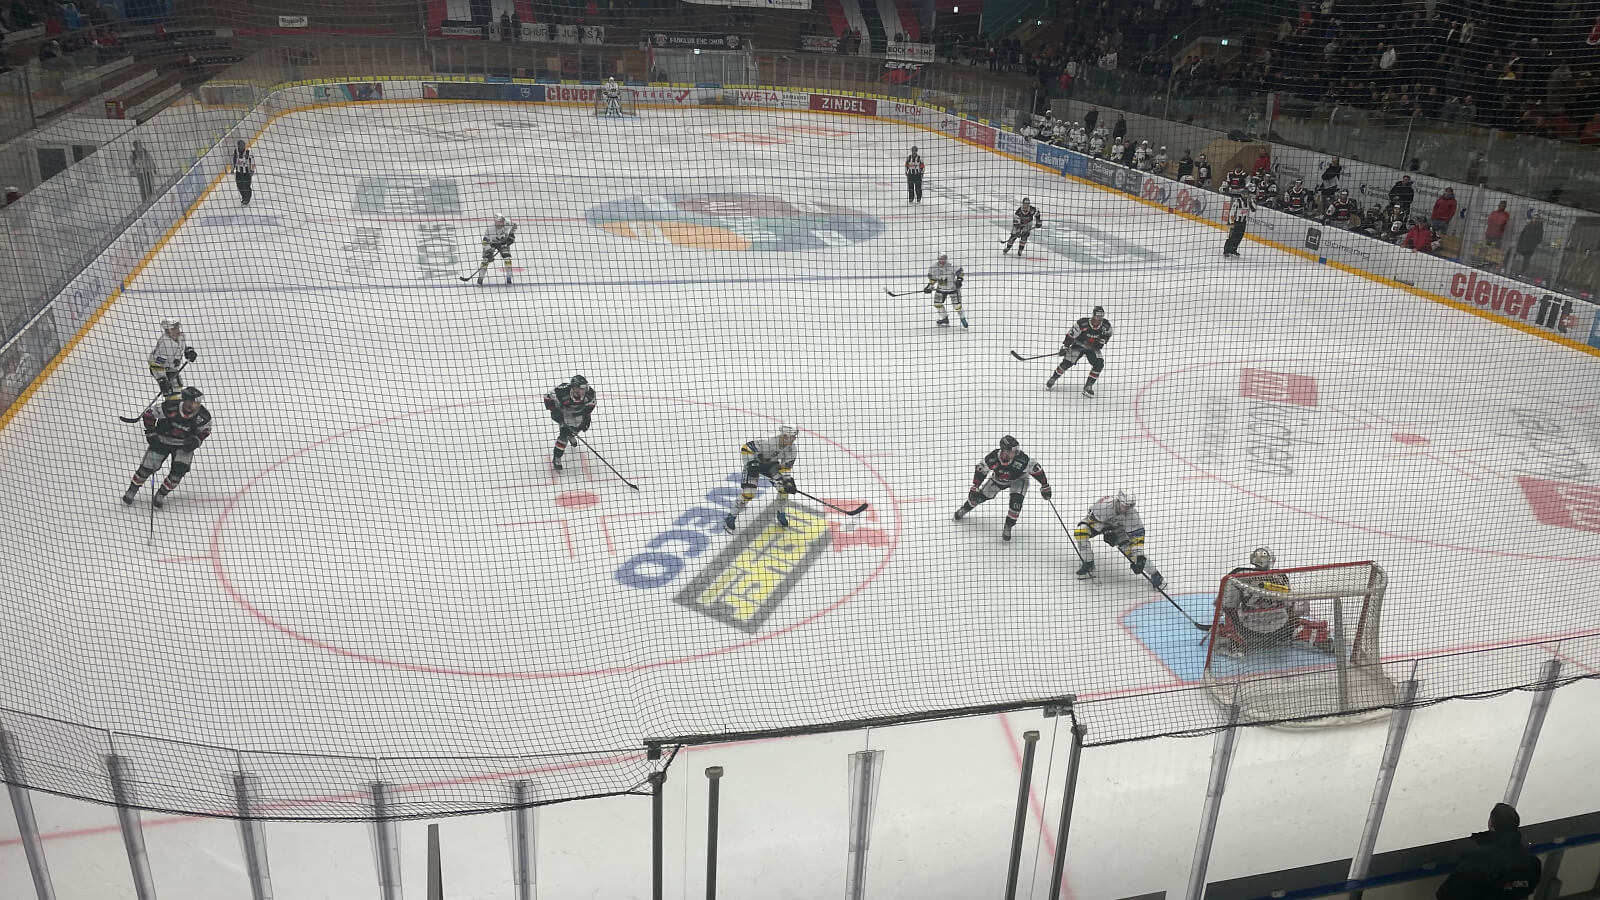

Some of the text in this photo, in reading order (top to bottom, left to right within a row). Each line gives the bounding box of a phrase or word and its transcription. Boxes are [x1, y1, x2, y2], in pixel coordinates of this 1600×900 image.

[547, 86, 595, 102] clever
[740, 90, 779, 102] WETA
[821, 97, 866, 113] ZINDEL
[895, 103, 922, 116] RICOH
[1450, 272, 1574, 334] clever fit
